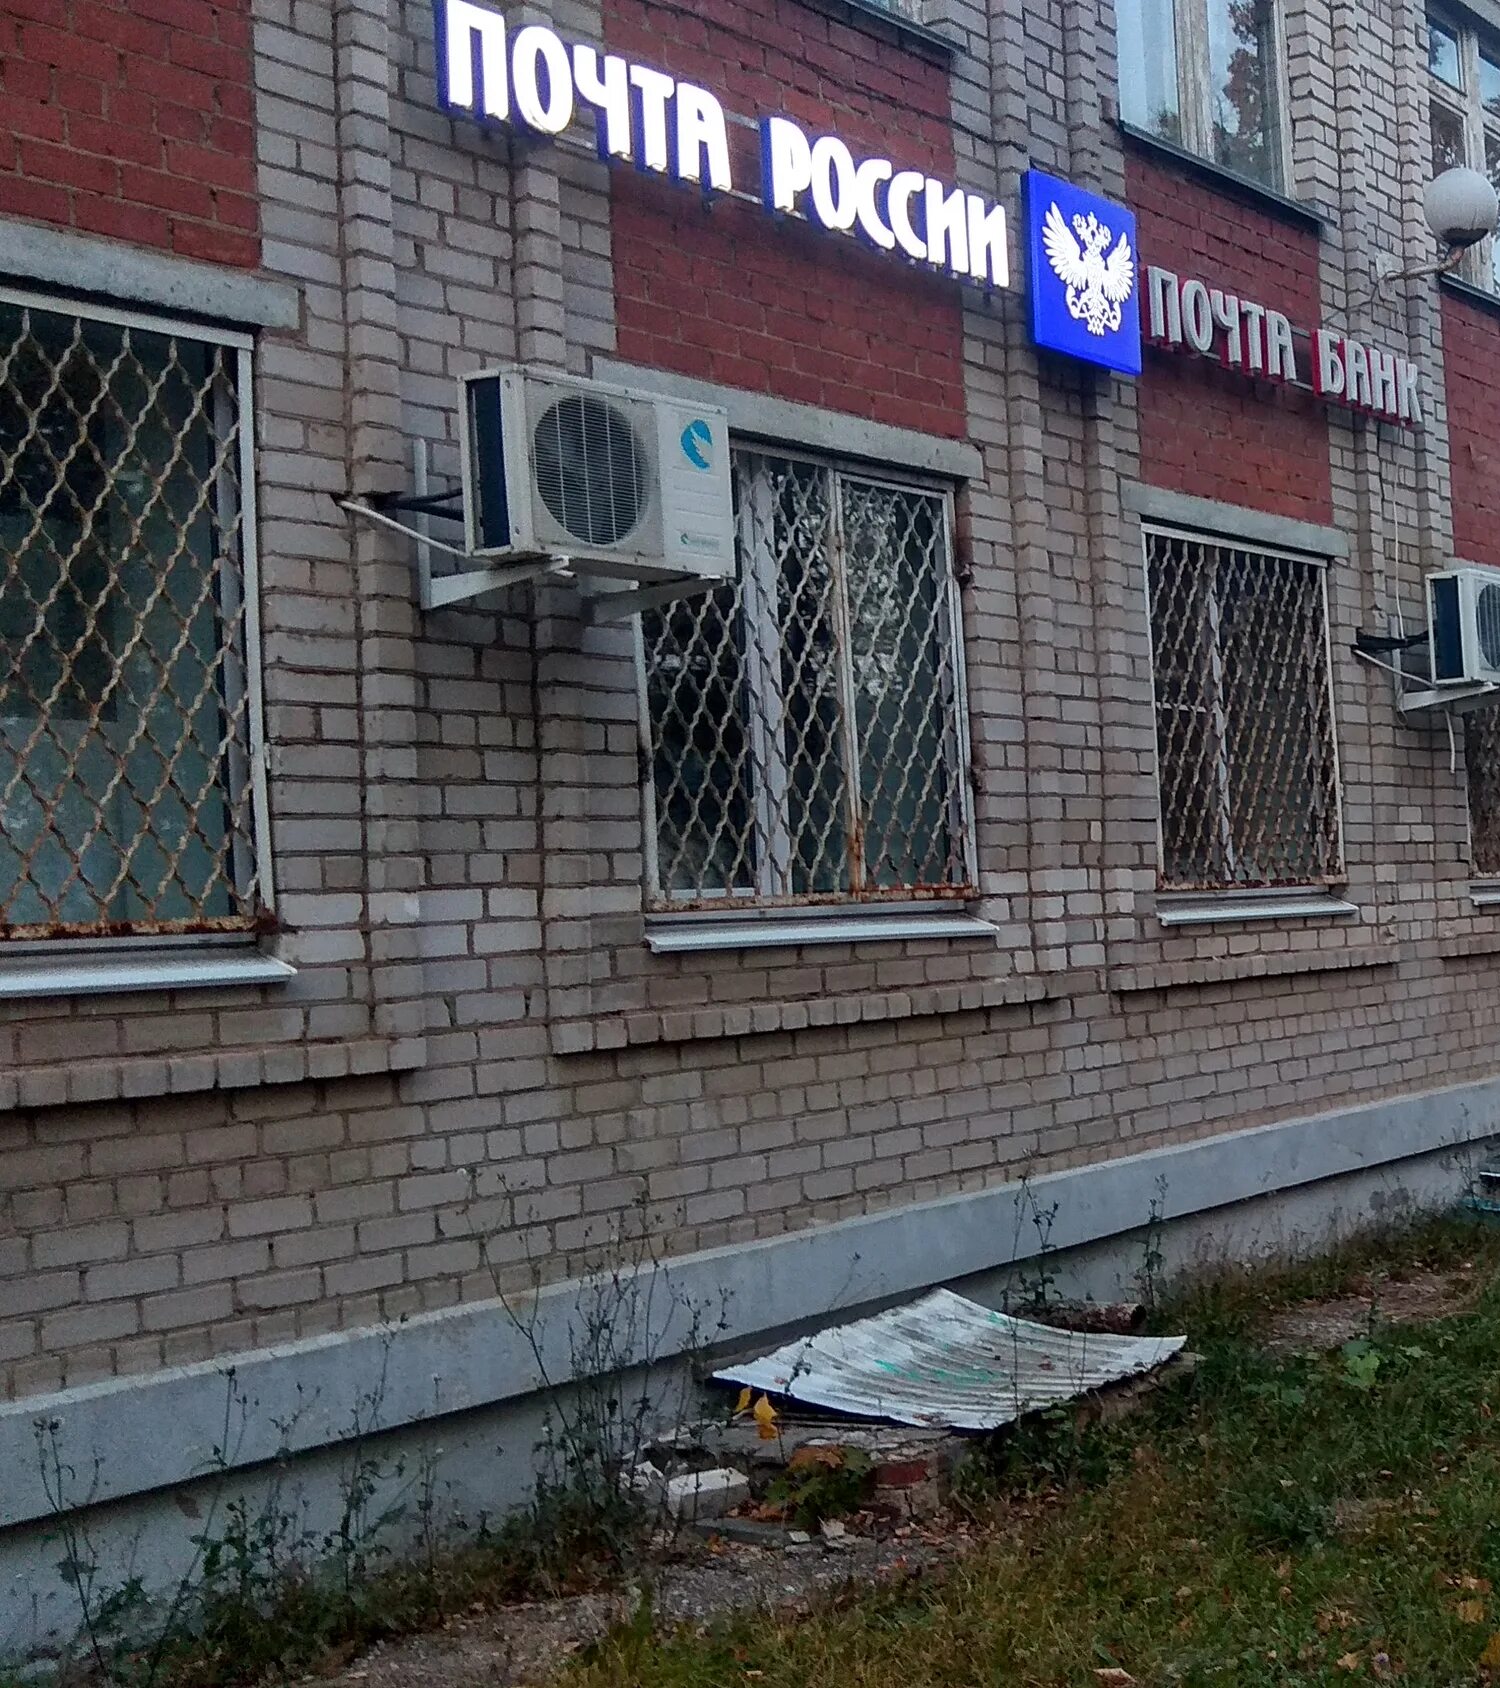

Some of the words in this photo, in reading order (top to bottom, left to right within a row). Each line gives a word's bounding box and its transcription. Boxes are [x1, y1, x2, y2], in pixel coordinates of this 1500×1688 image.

[445, 0, 733, 192] ПОЧТА
[768, 115, 1010, 288] РОССИИ
[1146, 265, 1298, 383] ПОЧТА
[1314, 328, 1424, 425] БАНК
